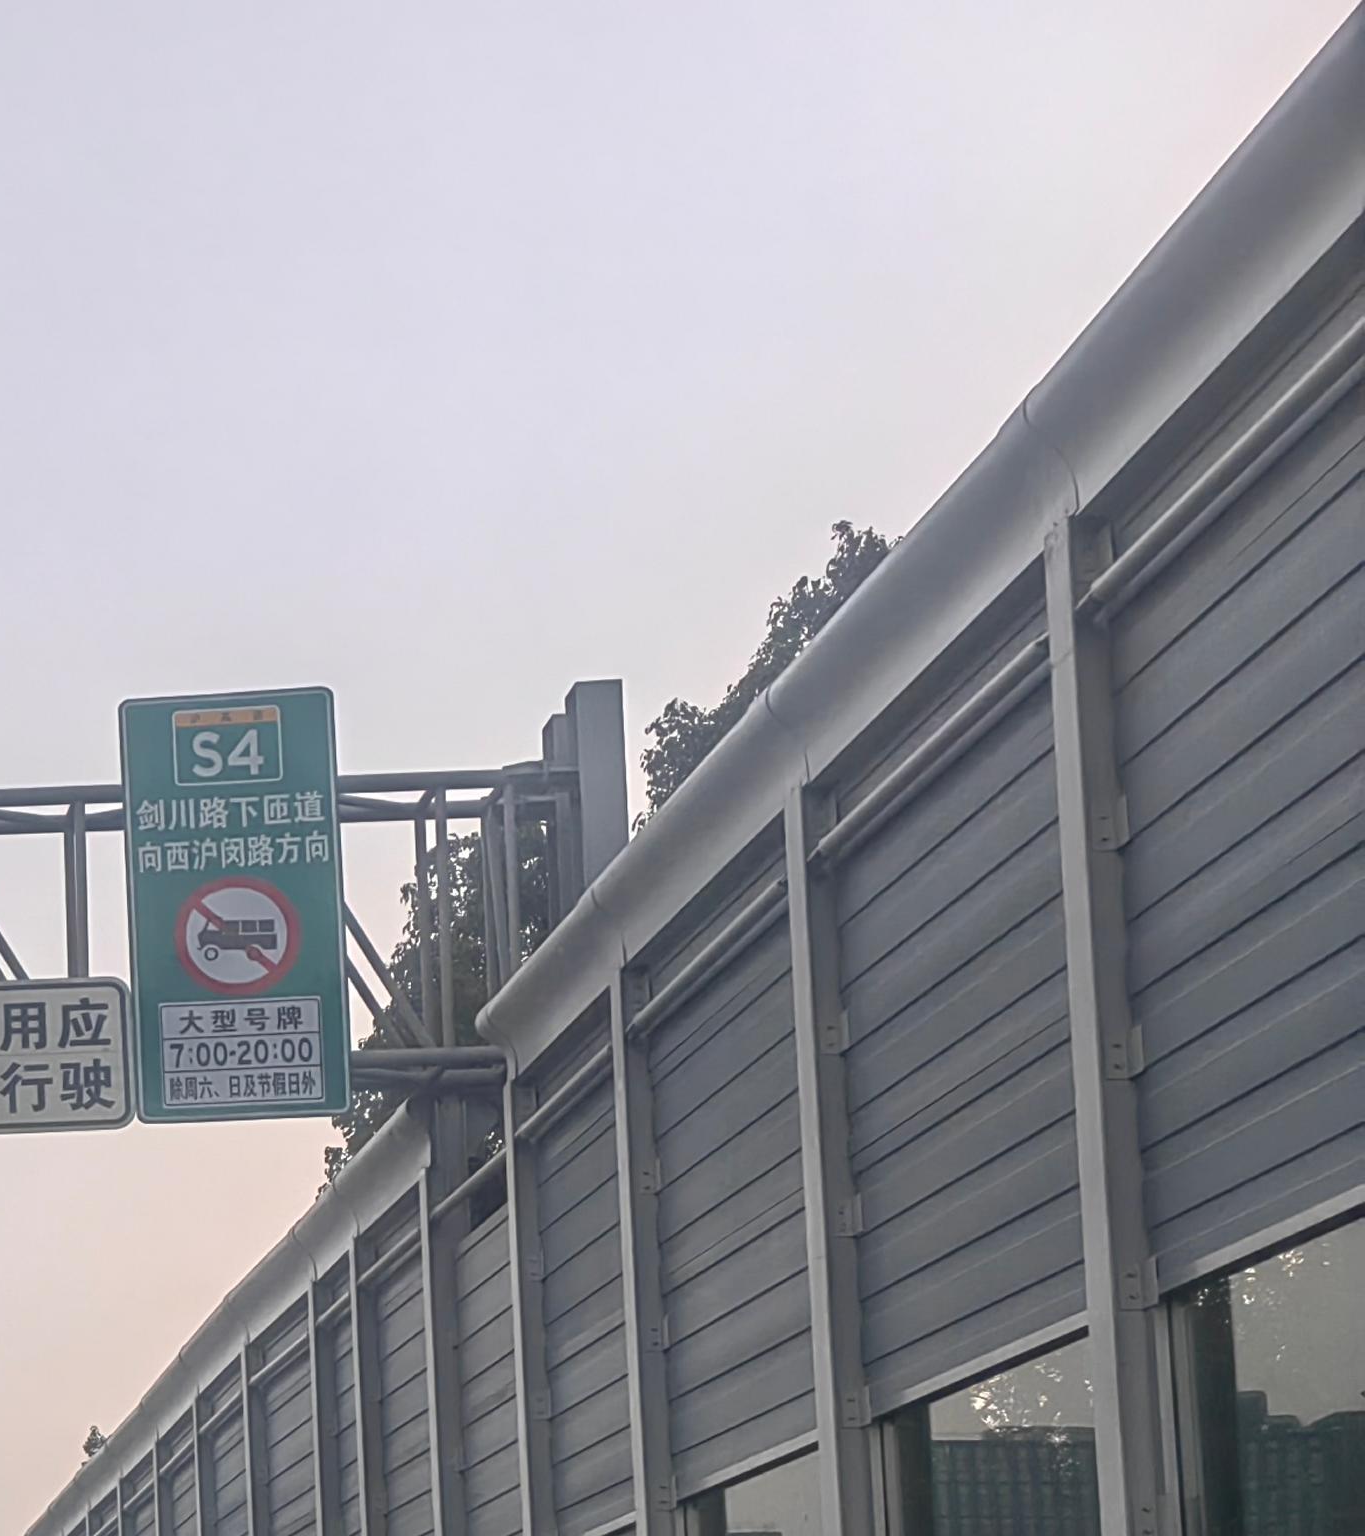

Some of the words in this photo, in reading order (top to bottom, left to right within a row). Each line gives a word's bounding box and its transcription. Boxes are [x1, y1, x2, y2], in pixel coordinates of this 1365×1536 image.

[192, 728, 264, 778] S4
[136, 790, 326, 832] 剑川路下匝道
[137, 830, 330, 874] 向西沪闵路方向
[178, 1005, 304, 1035] 大型号牌
[169, 1037, 314, 1069] 7:00-20:00
